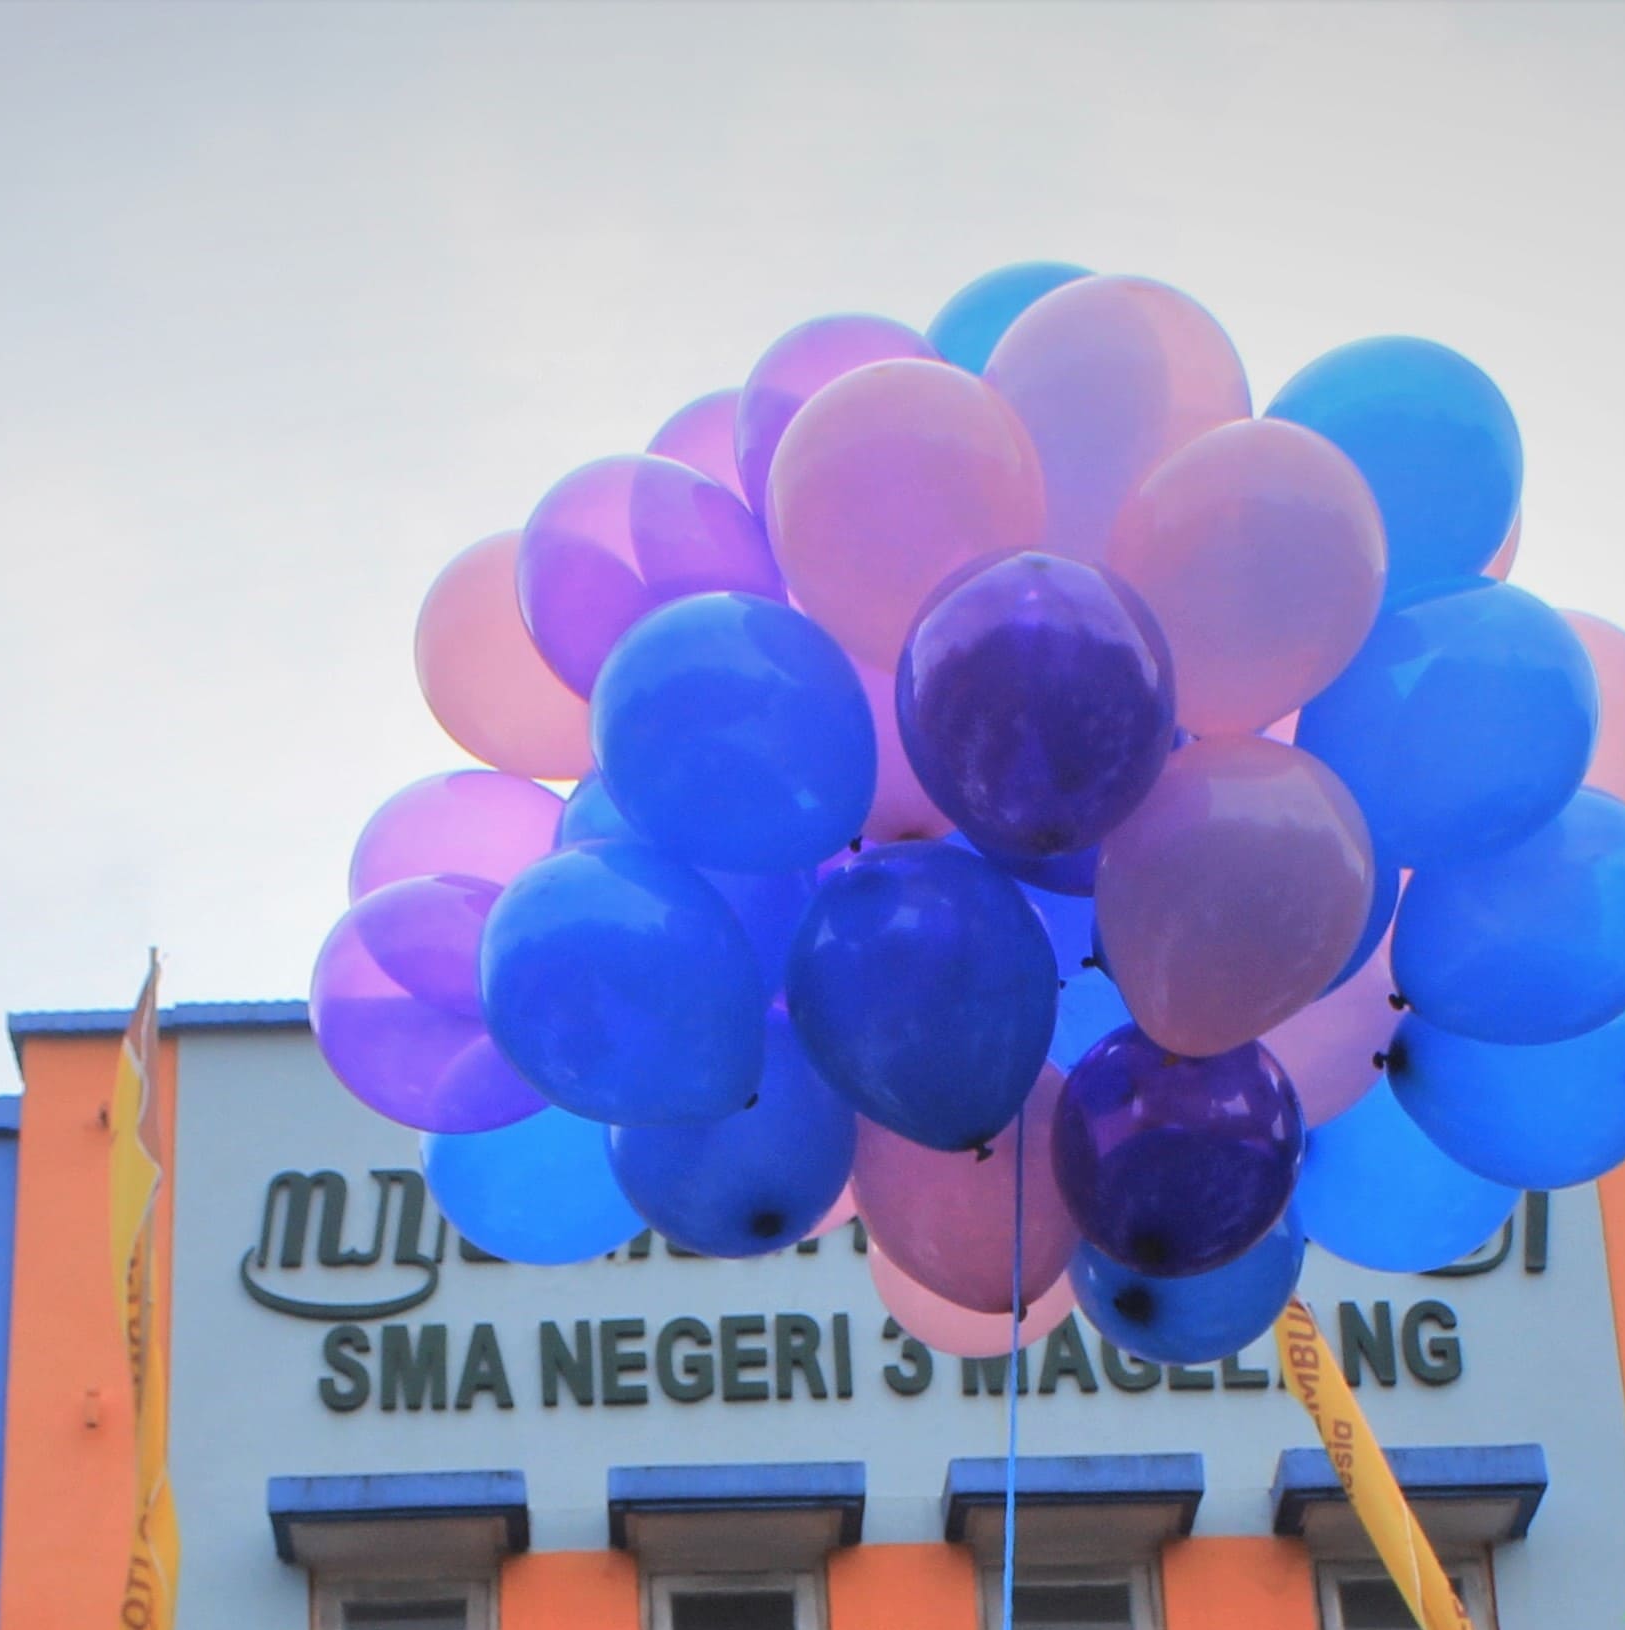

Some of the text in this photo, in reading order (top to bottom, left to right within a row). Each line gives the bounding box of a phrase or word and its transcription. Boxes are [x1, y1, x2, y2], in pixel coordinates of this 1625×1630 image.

[318, 1321, 515, 1415] SMA
[539, 1312, 855, 1407] NEGERI
[882, 1316, 934, 1397] 3
